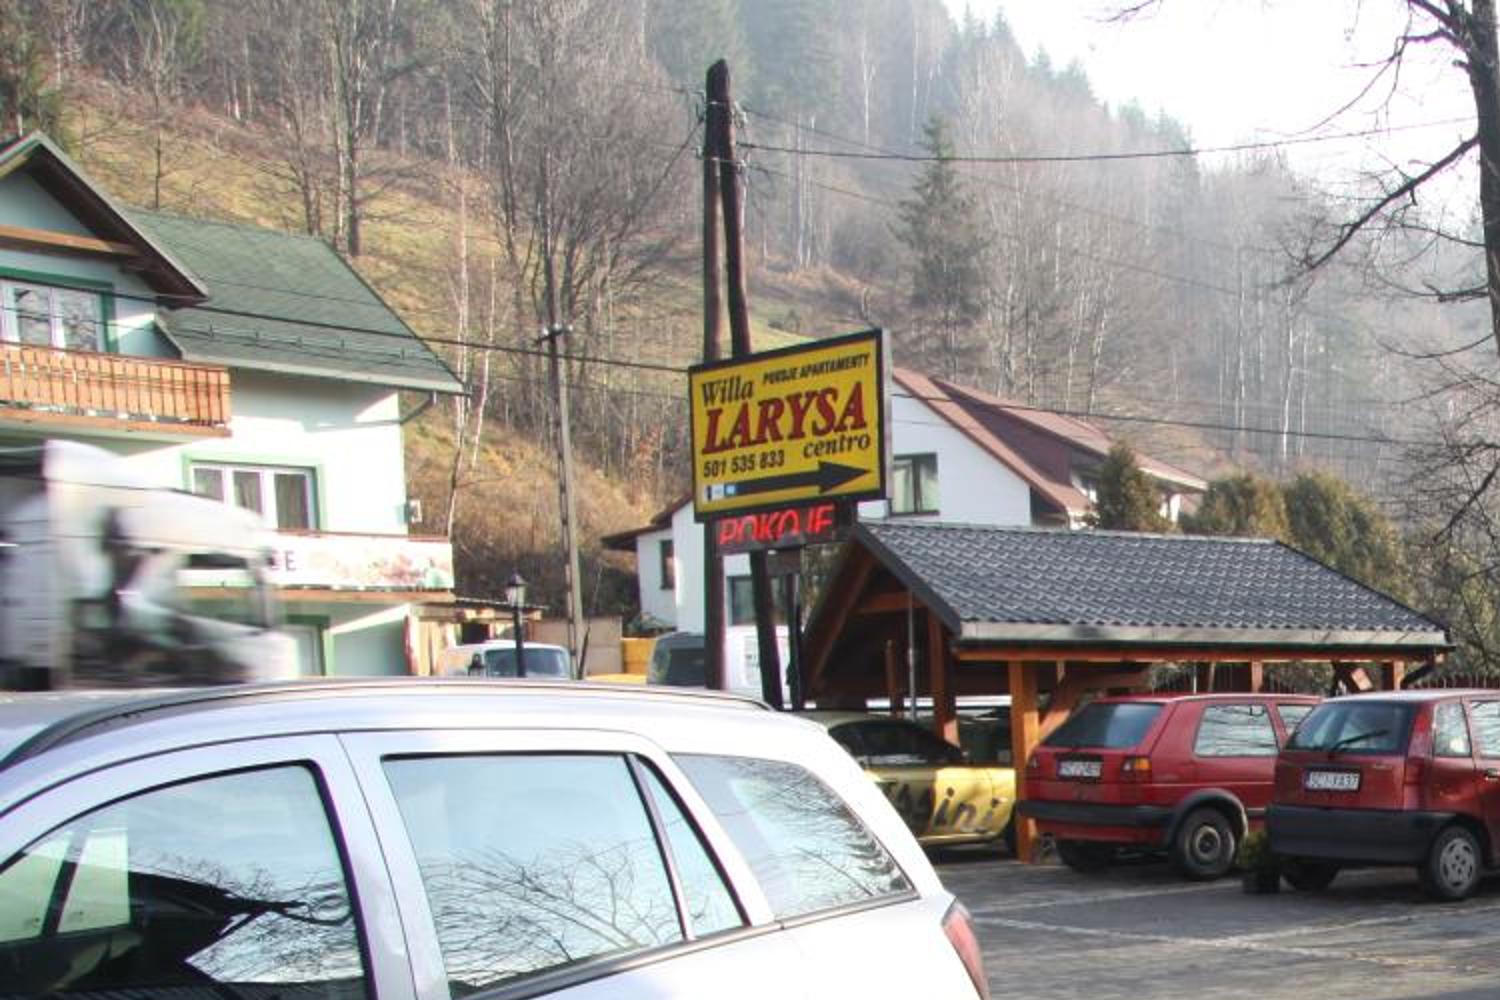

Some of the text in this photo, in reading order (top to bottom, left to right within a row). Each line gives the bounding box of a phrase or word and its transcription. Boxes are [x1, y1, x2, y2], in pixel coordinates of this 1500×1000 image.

[799, 352, 871, 380] APARTAMENTY
[702, 375, 754, 406] Willa
[702, 381, 867, 455] LARYSA
[803, 434, 871, 459] centro
[703, 449, 785, 478] 501 535 833
